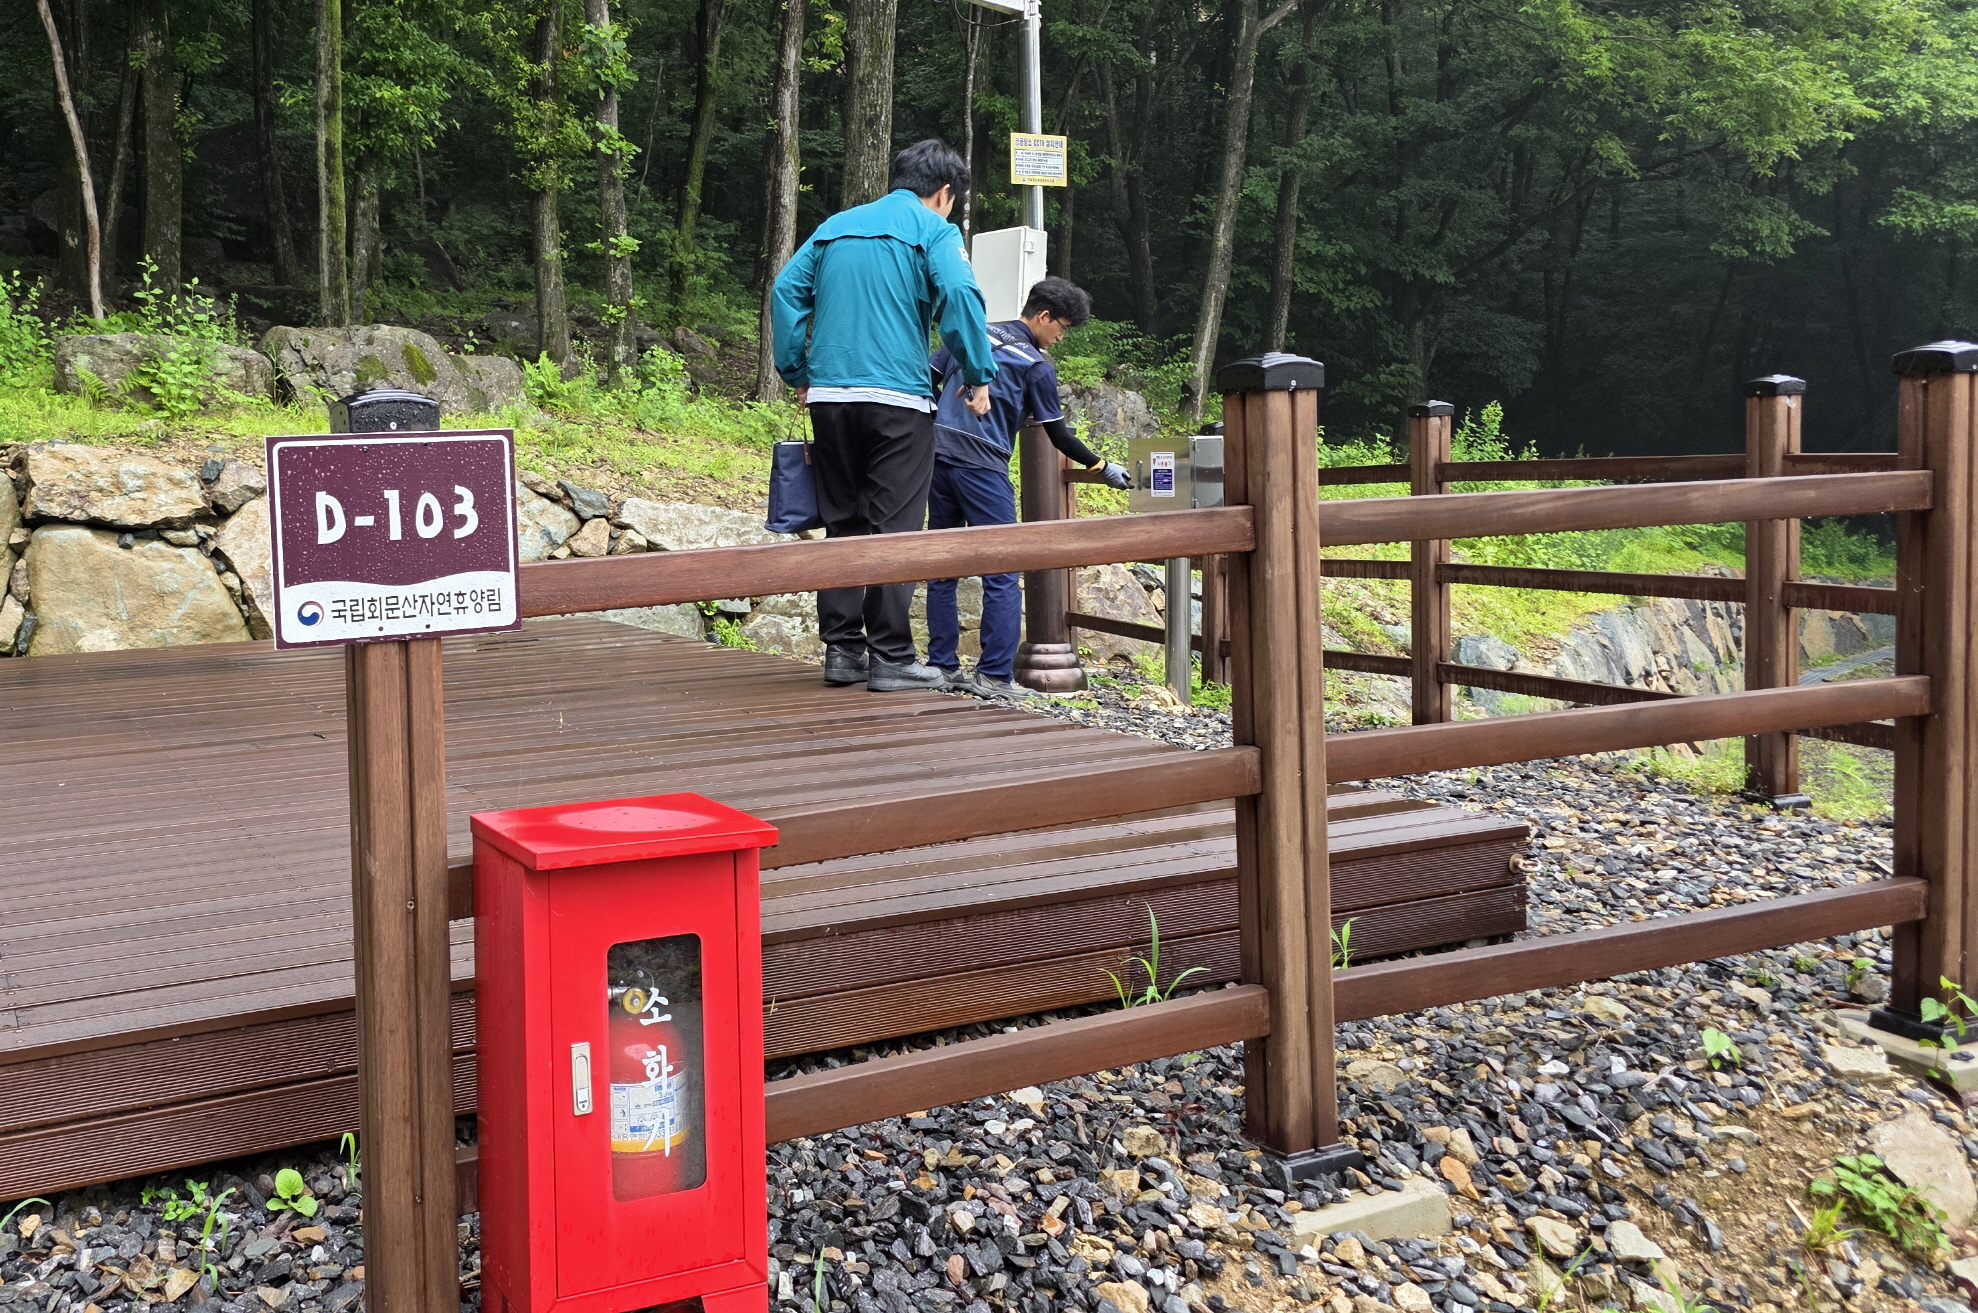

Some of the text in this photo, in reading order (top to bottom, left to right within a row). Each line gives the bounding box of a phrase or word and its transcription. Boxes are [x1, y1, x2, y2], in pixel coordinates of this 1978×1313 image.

[315, 485, 479, 545] D-103
[331, 587, 502, 624] 국립회문산자연휴양림
[639, 986, 673, 1157] 소화기
